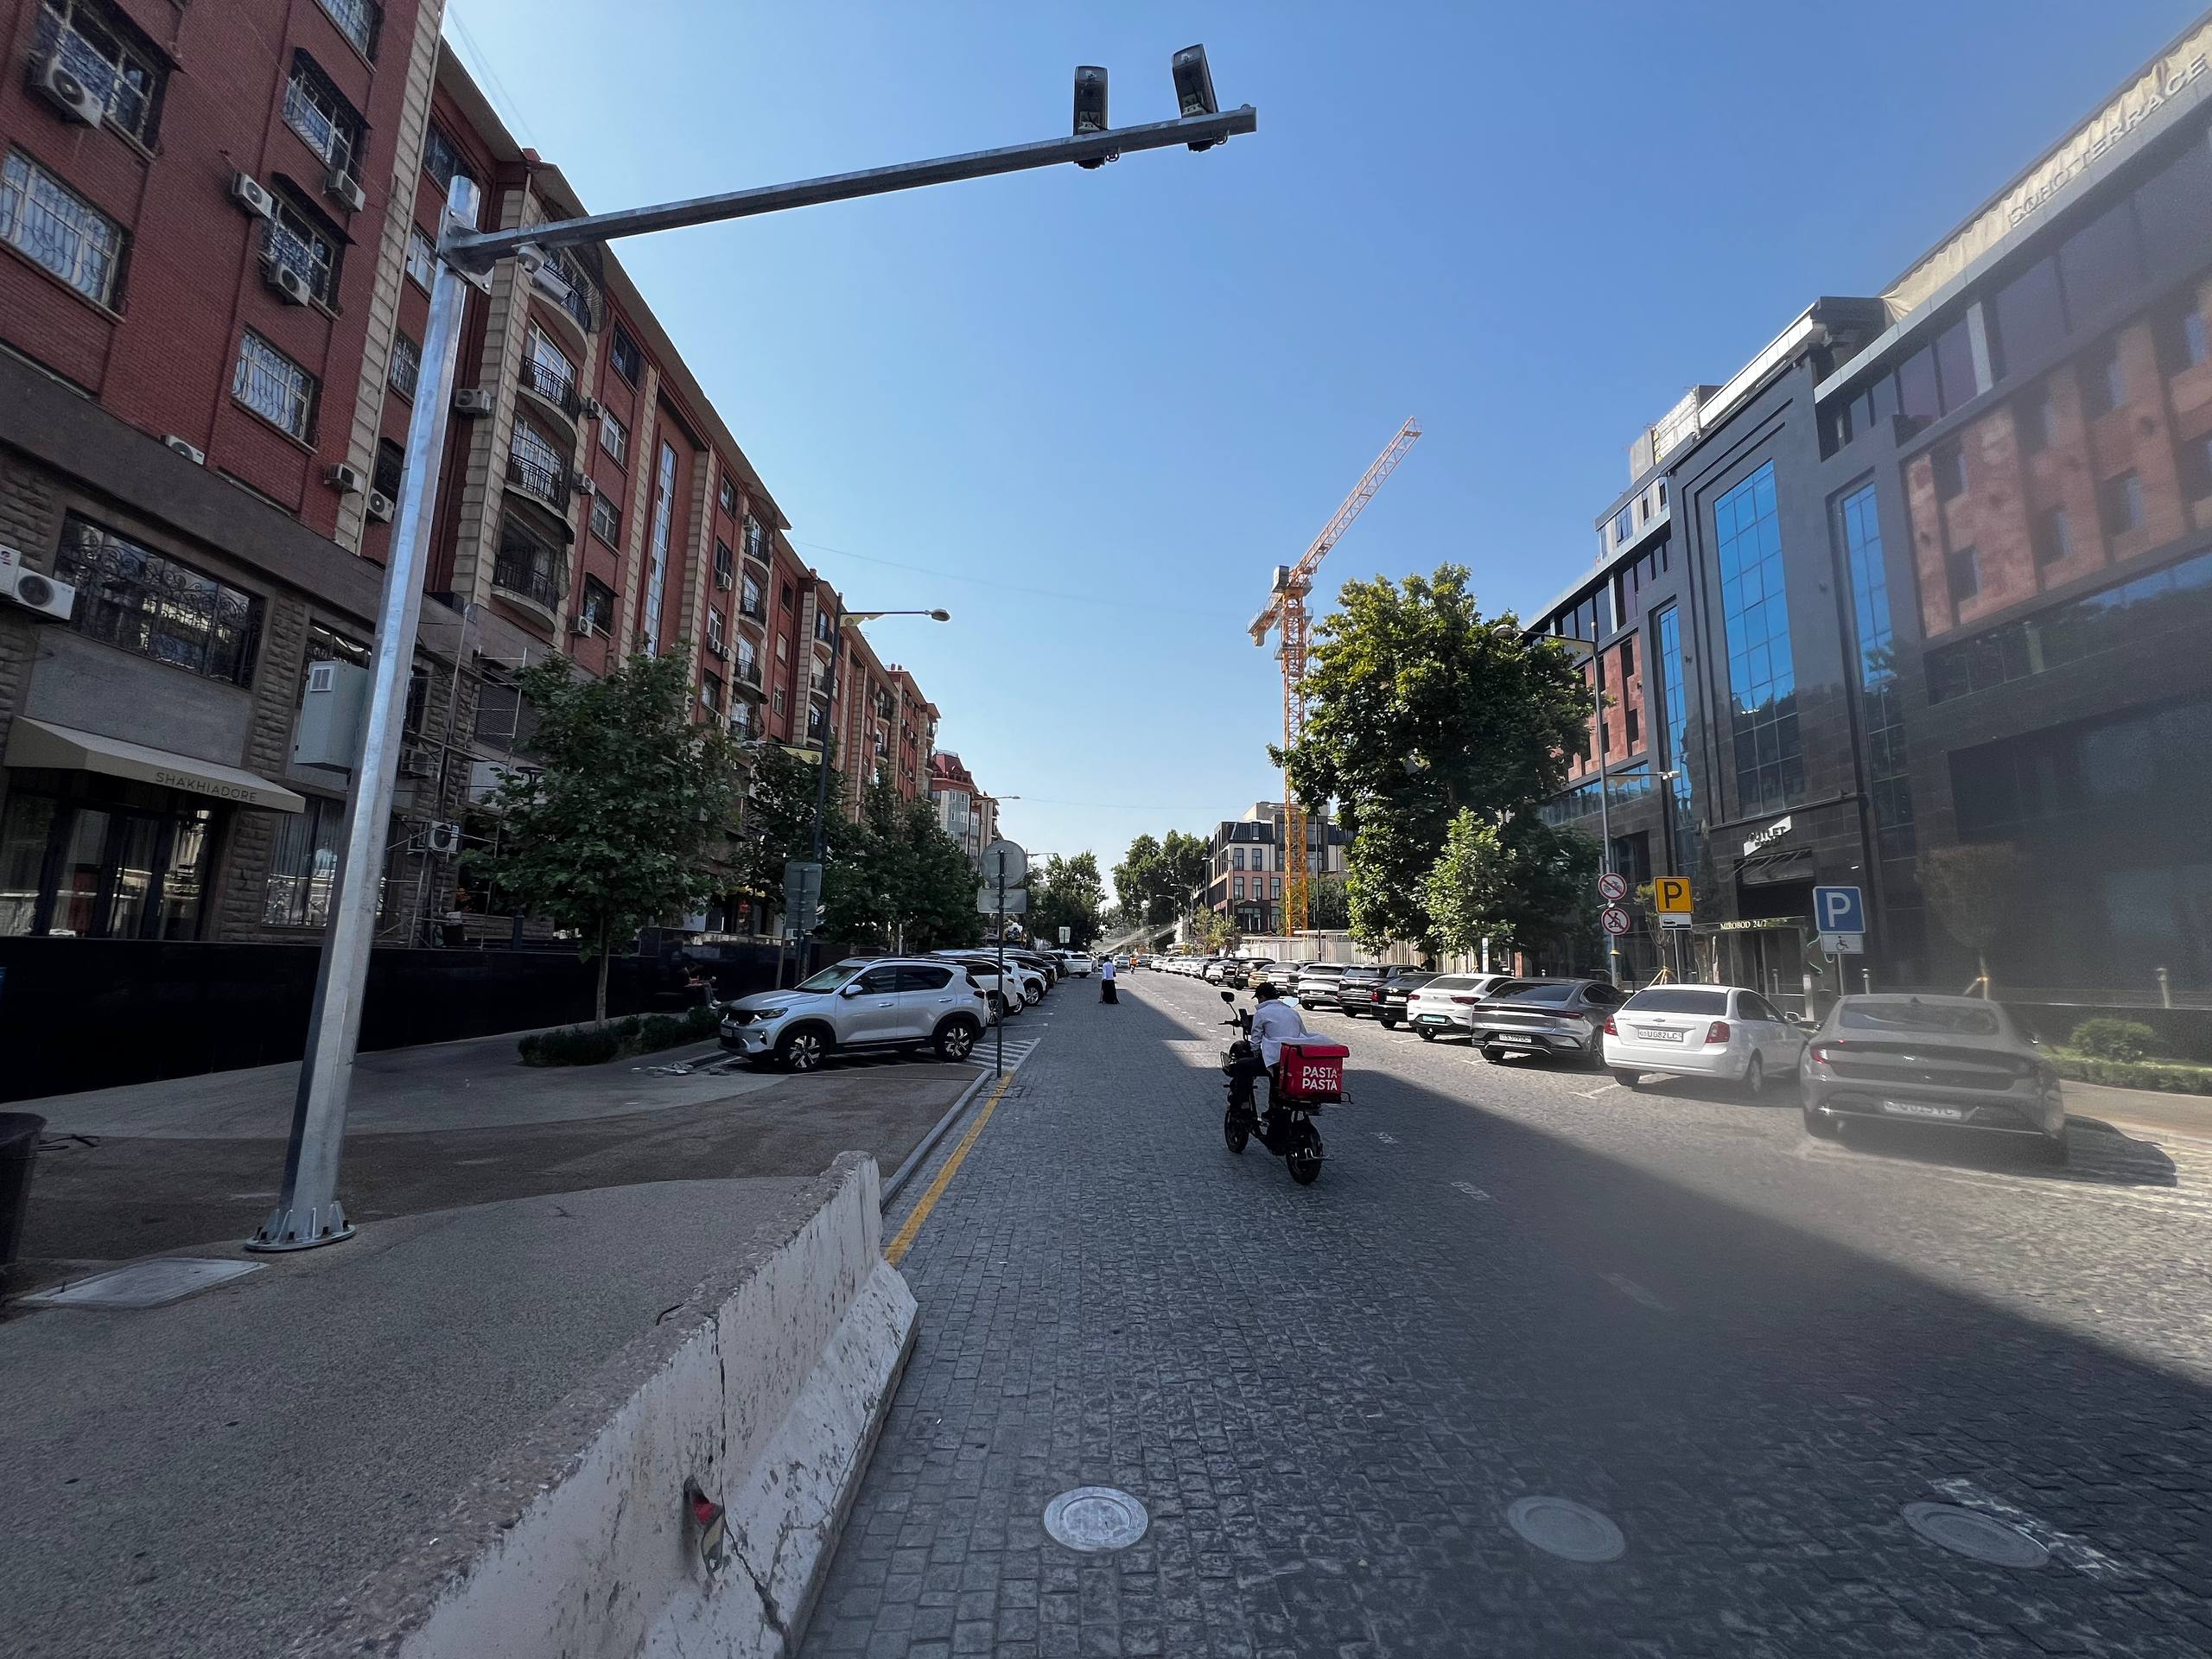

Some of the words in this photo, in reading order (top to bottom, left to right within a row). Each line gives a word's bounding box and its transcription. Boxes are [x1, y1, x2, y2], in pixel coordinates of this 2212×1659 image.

[156, 772, 257, 802] SHAKHIADORE
[1664, 882, 1682, 908] P
[1826, 893, 1851, 927] P
[1302, 1065, 1338, 1078] PASTA
[1302, 1077, 1338, 1090] PASTA
